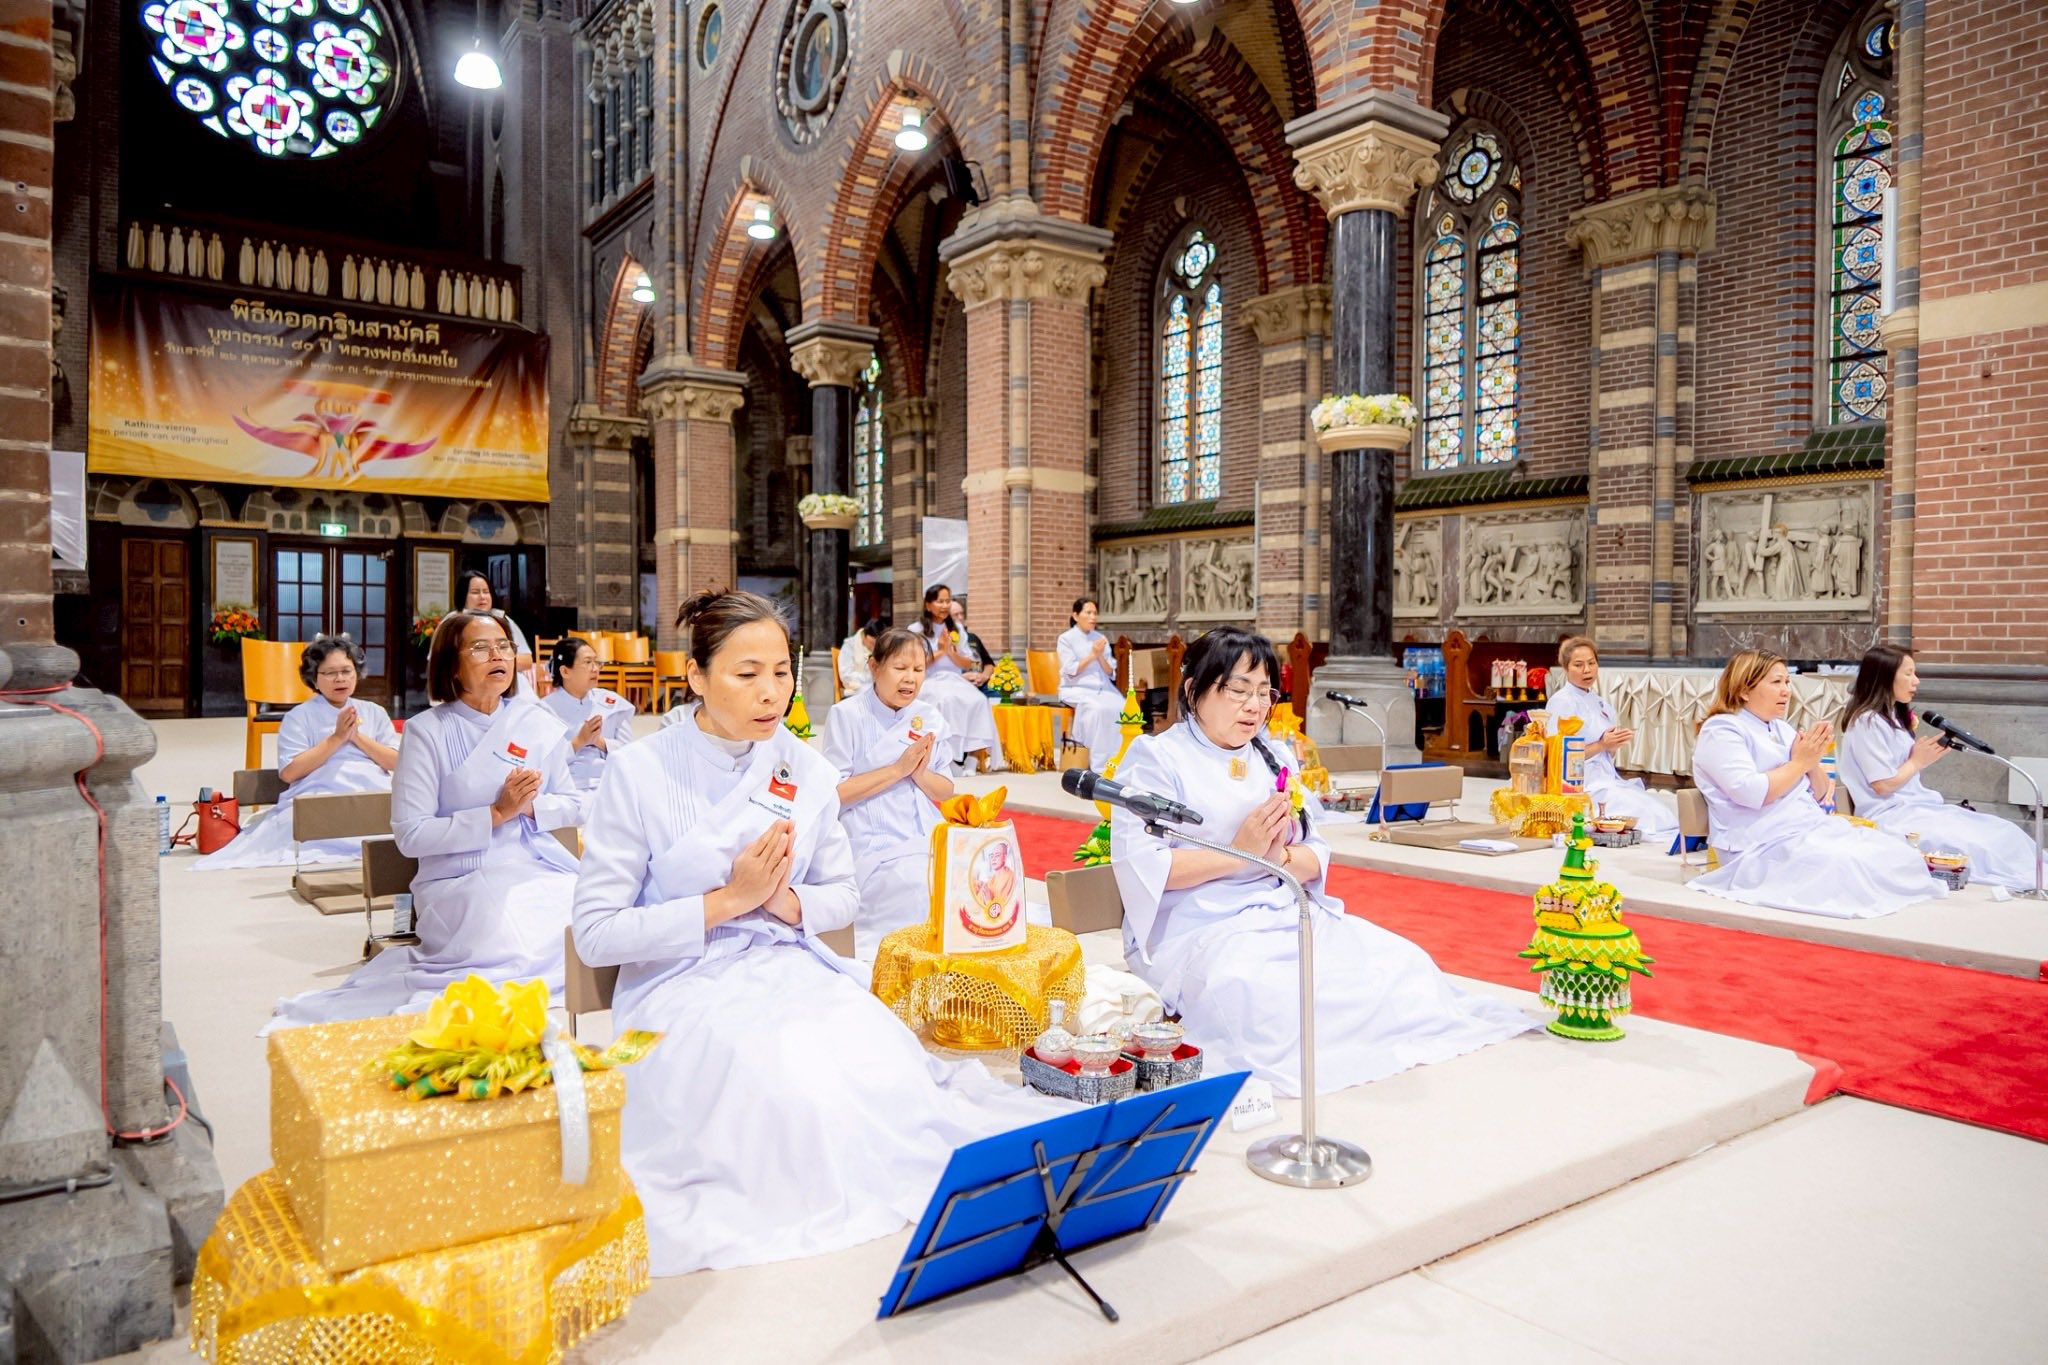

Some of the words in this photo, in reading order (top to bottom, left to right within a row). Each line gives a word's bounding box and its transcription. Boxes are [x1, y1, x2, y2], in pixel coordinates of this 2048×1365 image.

[230, 298, 440, 346] พิธีทอดกฐินสามัคคี
[208, 328, 284, 348] บูชาธรรม
[320, 337, 332, 354] ปี
[114, 428, 149, 438] periode
[153, 432, 169, 441] van
[124, 419, 197, 434] Kathina-viering
